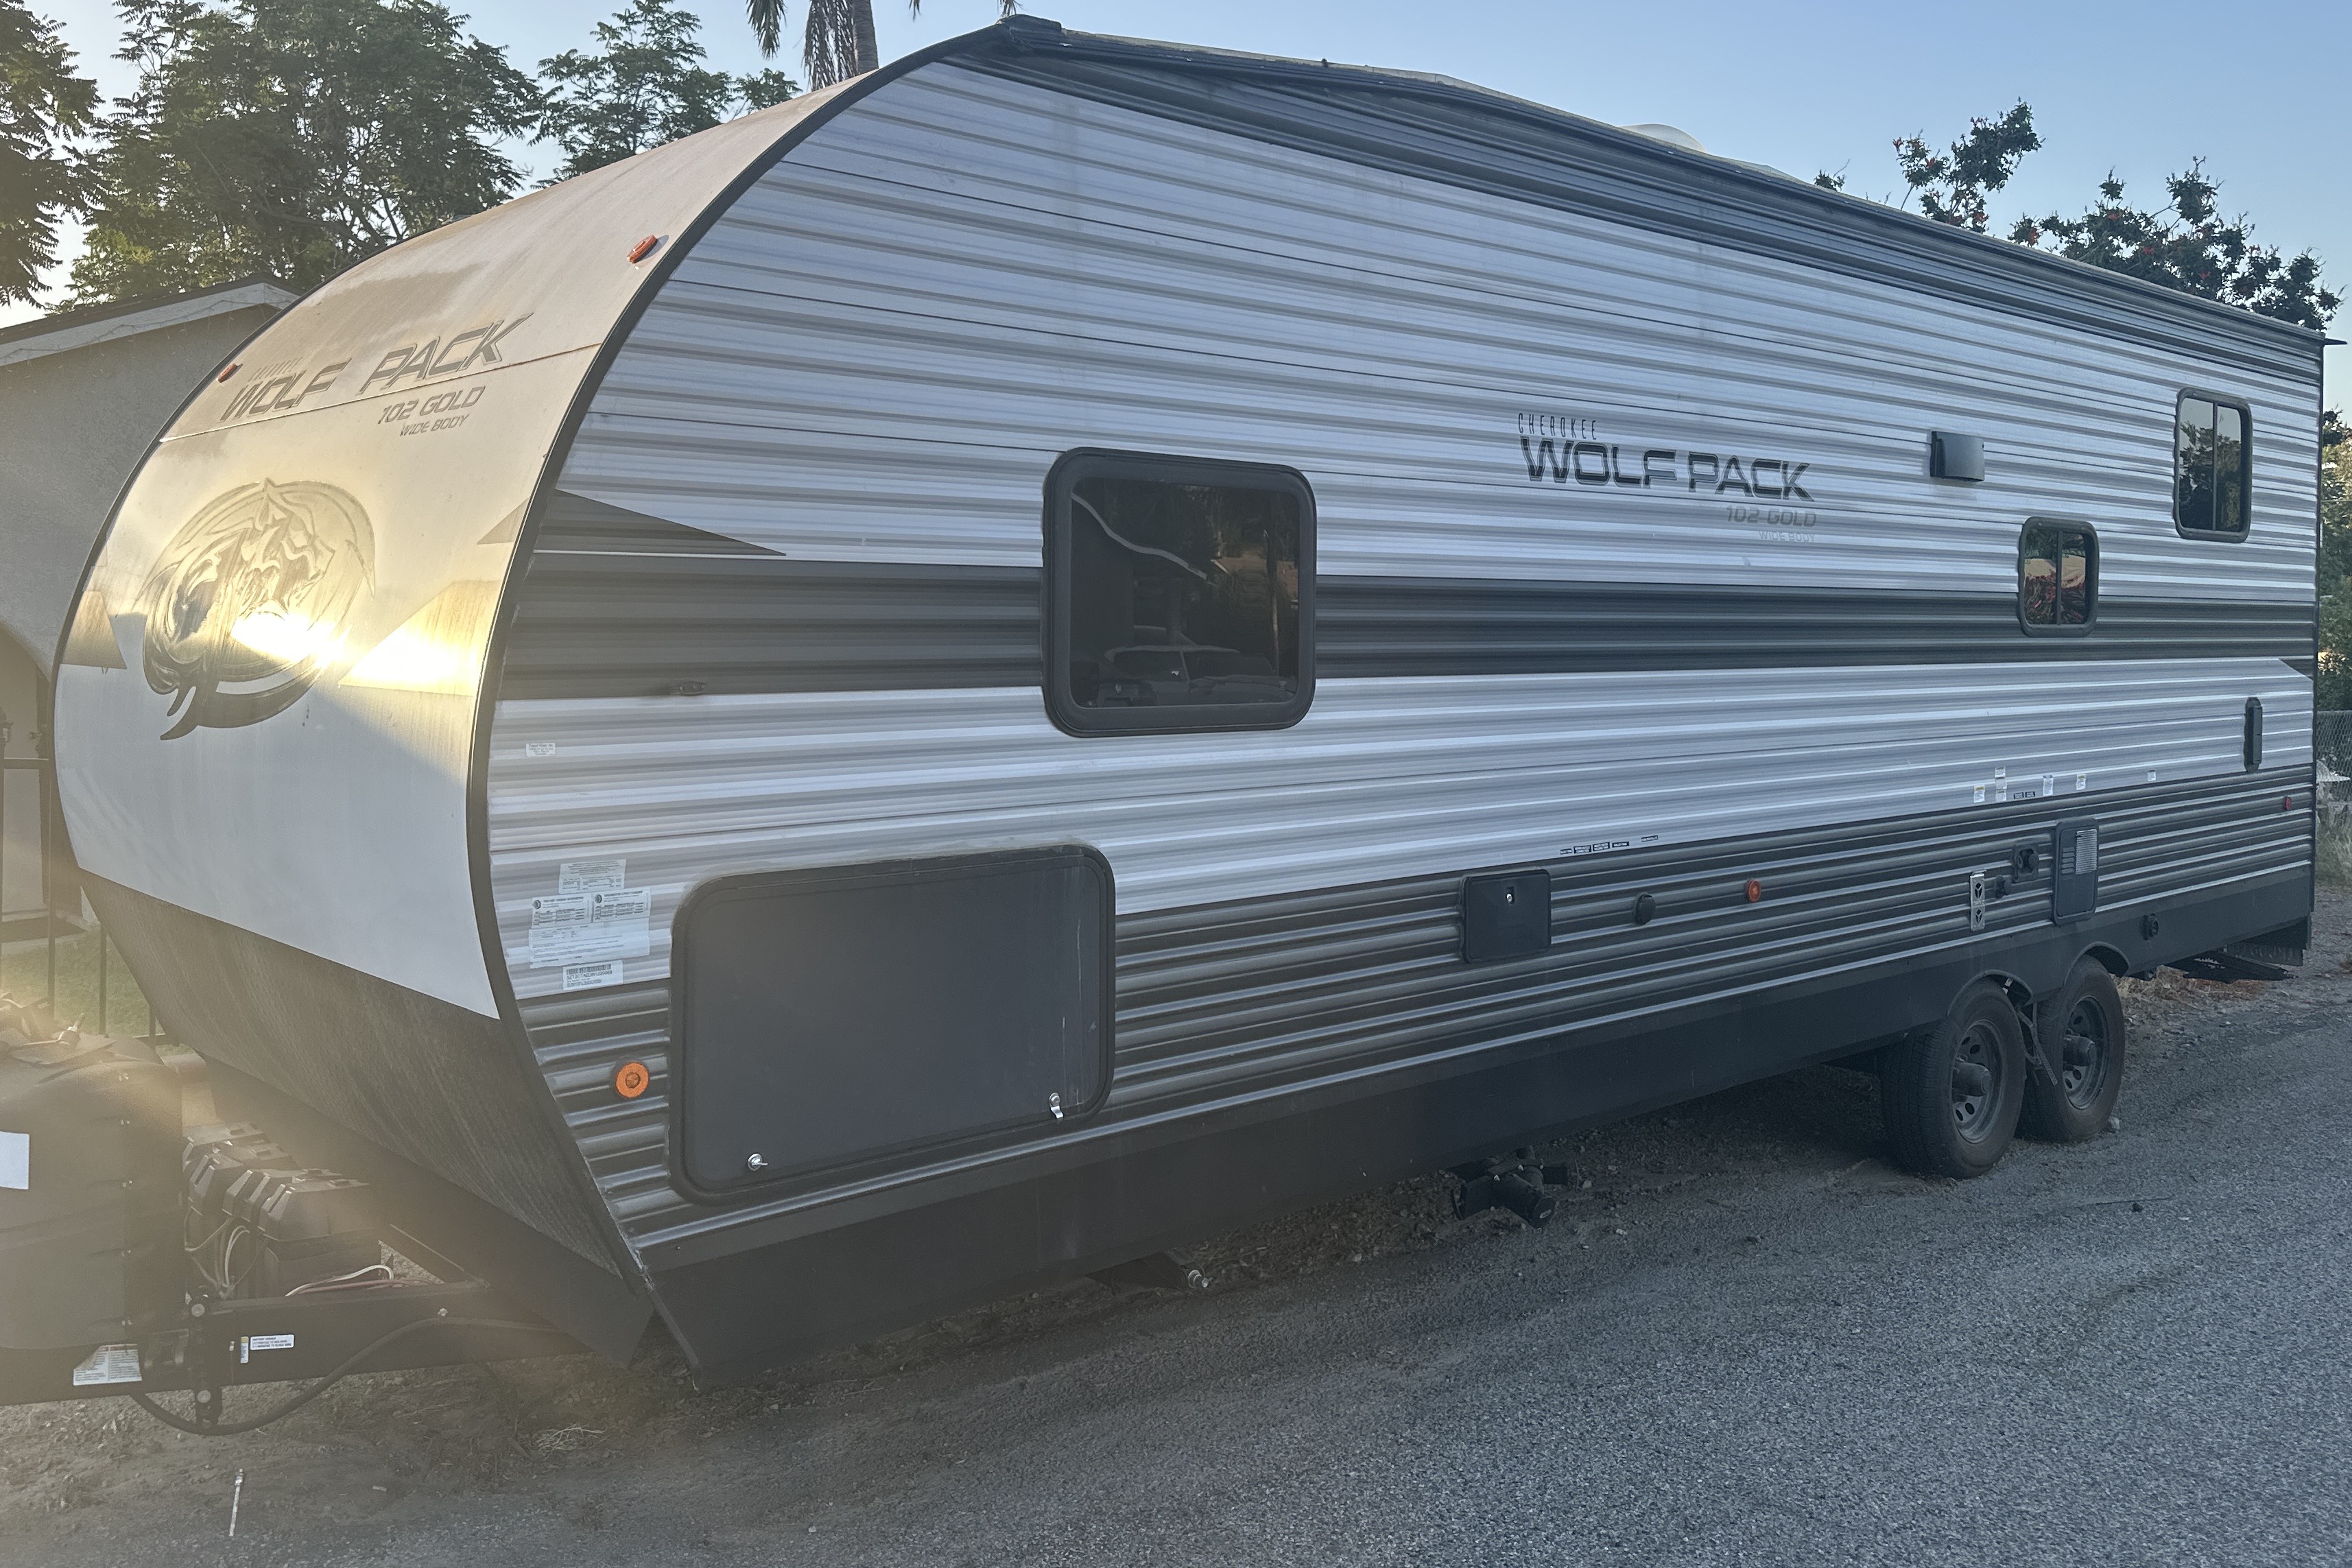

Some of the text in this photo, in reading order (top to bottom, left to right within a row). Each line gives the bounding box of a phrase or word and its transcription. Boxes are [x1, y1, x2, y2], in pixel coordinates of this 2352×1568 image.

[219, 312, 534, 422] WOLF PACK
[377, 385, 486, 425] 102 GOLD
[399, 414, 470, 437] WIDE BODY
[1518, 412, 1597, 440] CHEROKEE
[1520, 436, 1815, 502] WOLF PACK
[1726, 506, 1817, 527] 102 GOLD
